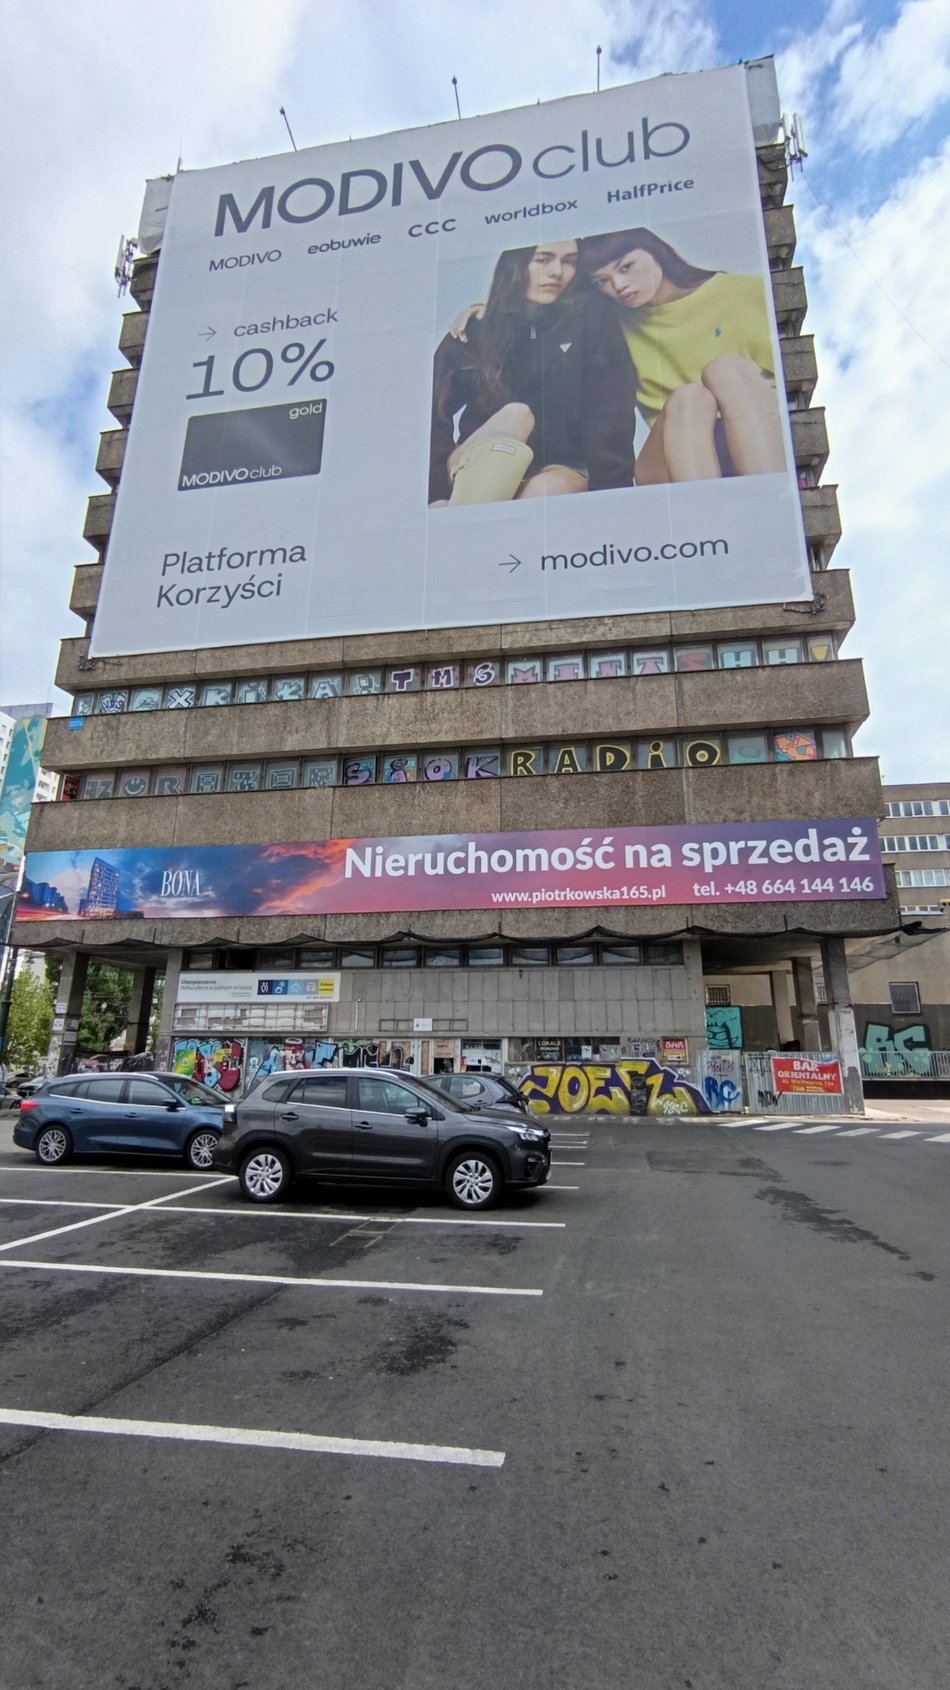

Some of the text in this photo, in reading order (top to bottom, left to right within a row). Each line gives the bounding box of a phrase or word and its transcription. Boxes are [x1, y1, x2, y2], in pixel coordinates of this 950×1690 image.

[208, 250, 281, 271] MODIVO
[308, 233, 381, 254] eobuwie
[485, 199, 578, 224] worldbox
[607, 178, 695, 203] HalfPrice
[233, 308, 338, 337] cashback
[186, 338, 334, 400] 10%
[289, 402, 323, 419] gold
[161, 545, 307, 576] Platforma
[541, 538, 728, 570] modivo.com
[157, 573, 283, 609] Korzyści
[344, 826, 871, 878] Nieruchomość na sprzedaż
[491, 884, 666, 904] www.piotrkowska165.pl
[693, 876, 874, 896] tel. +48 664 144 146
[777, 1070, 836, 1081] ORIENTALNY
[793, 1060, 820, 1072] BAR
